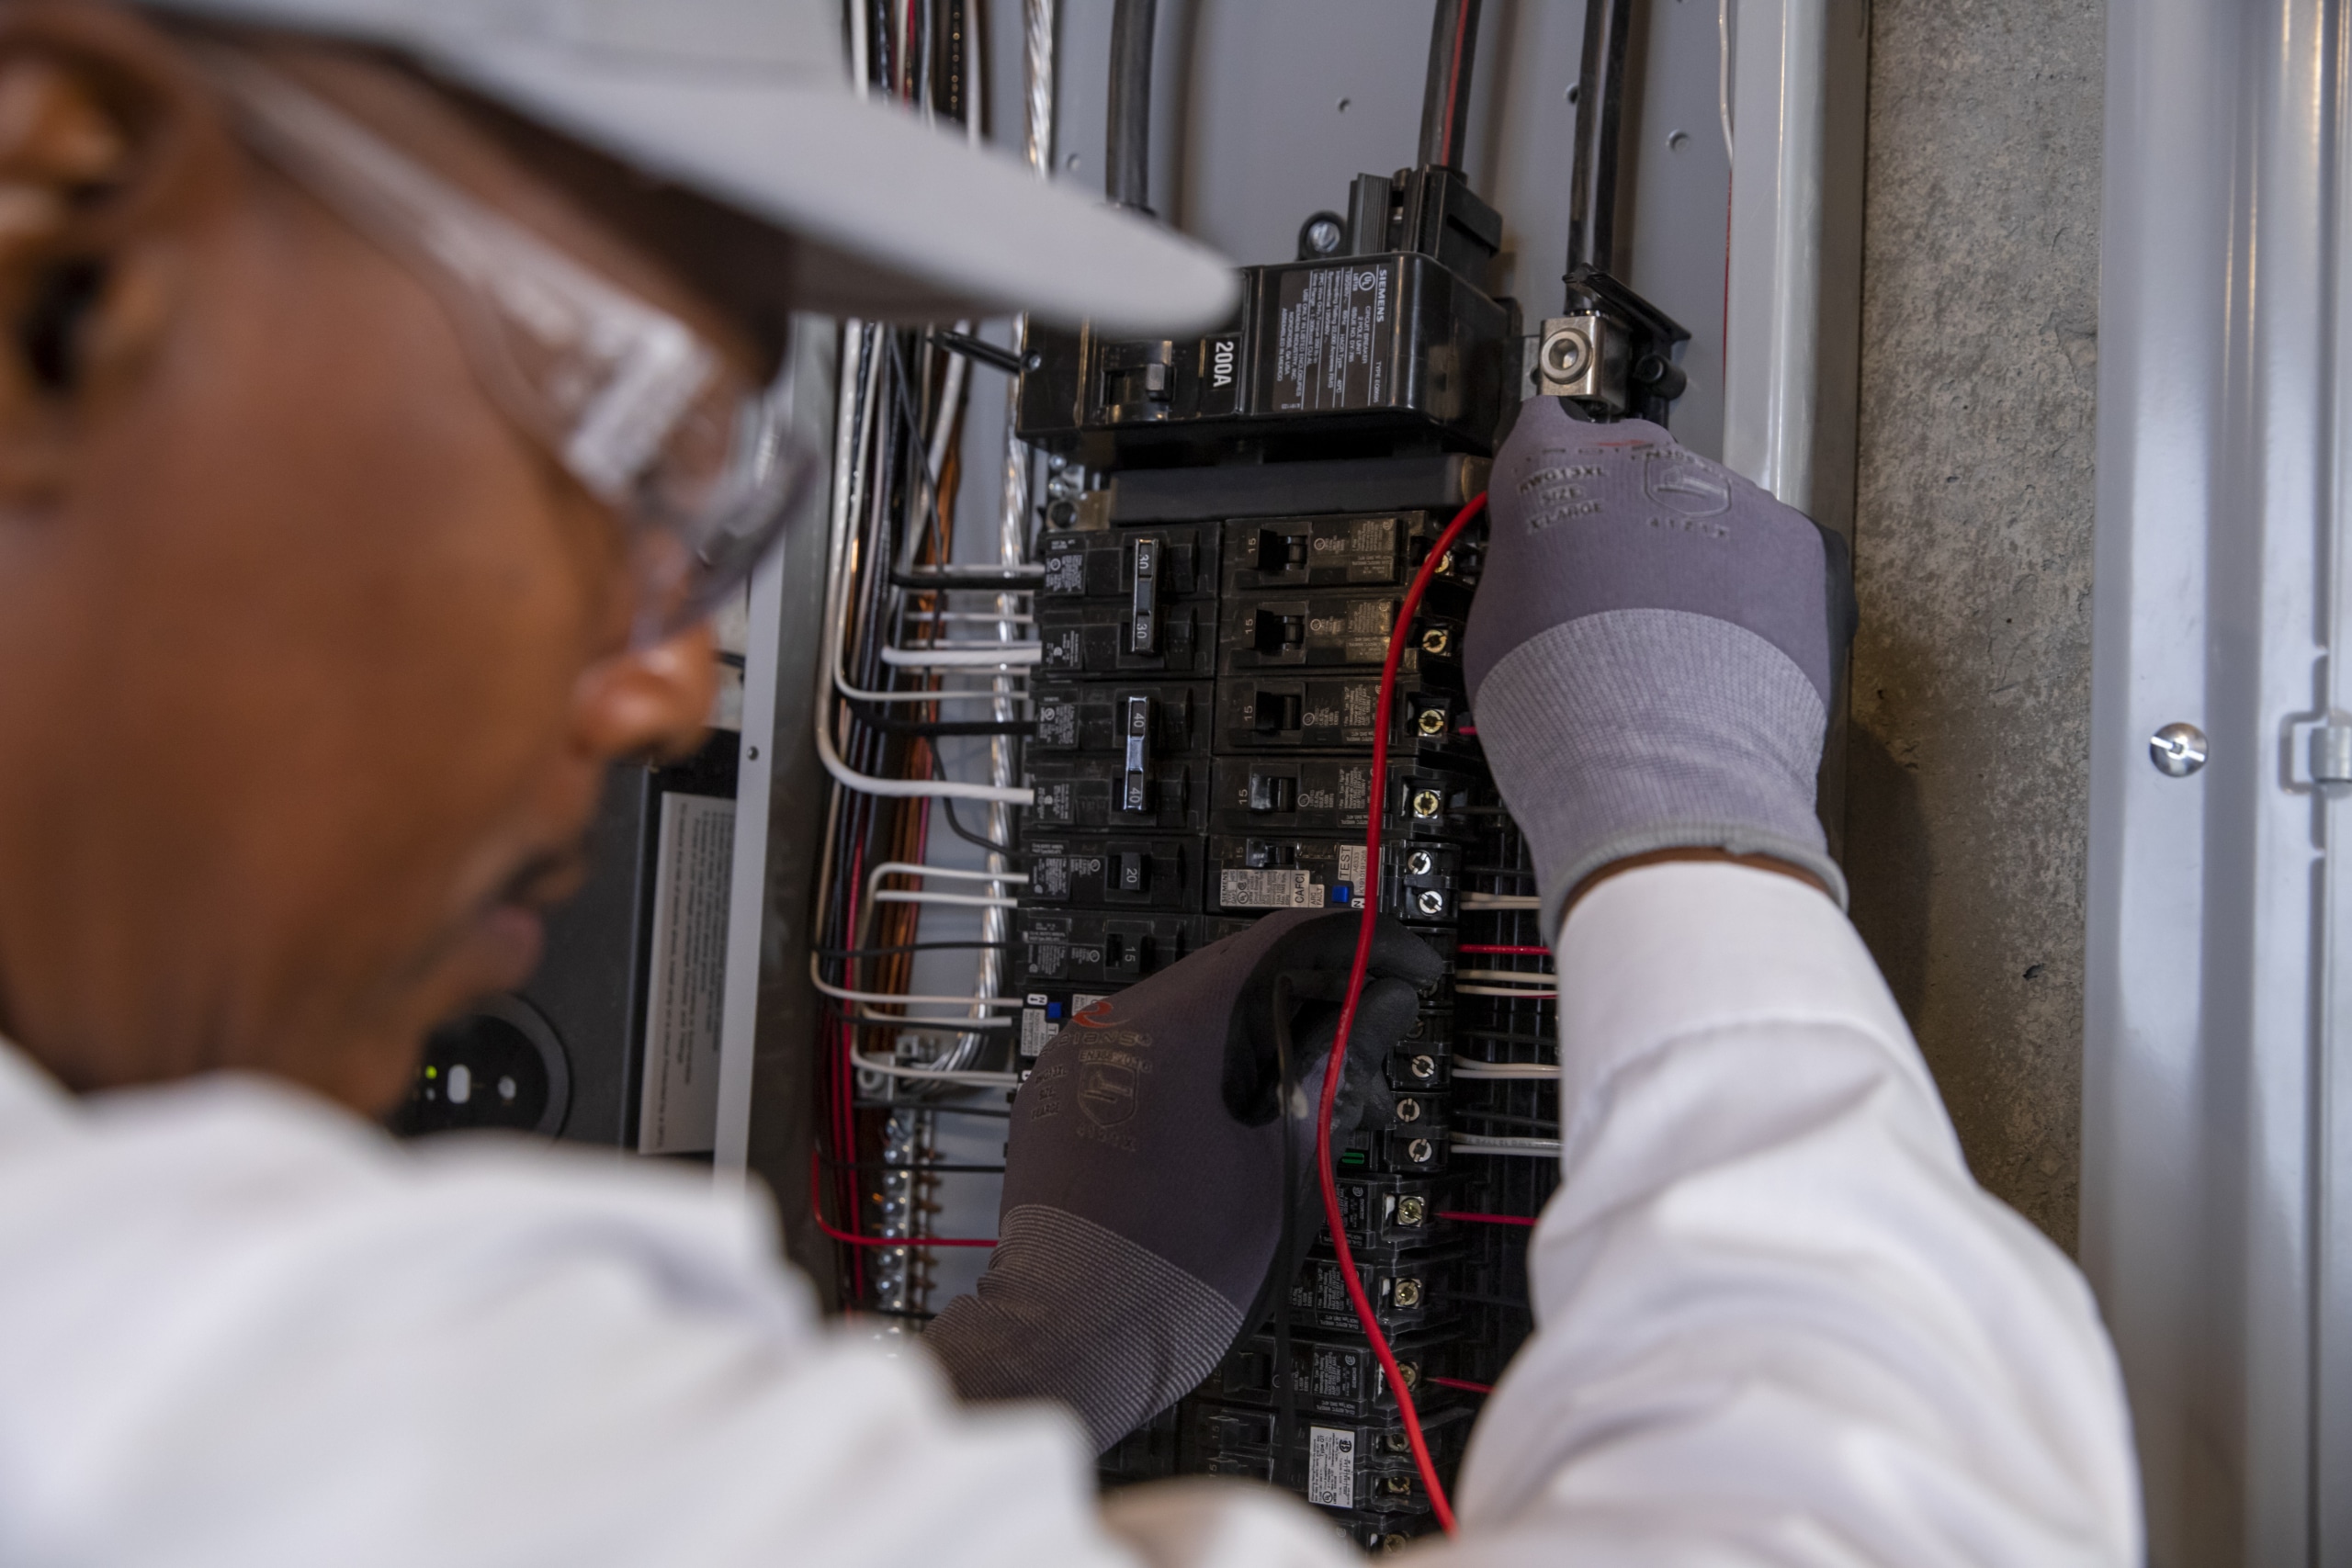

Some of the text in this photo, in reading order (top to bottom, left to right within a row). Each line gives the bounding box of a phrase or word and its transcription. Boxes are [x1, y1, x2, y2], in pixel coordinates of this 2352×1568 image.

[1376, 269, 1387, 322] SIEMENS
[1213, 341, 1234, 387] 200A
[1248, 538, 1256, 554] 15
[1137, 623, 1147, 639] 30
[1245, 619, 1253, 635] 15
[1134, 712, 1145, 727] 40
[1244, 705, 1253, 721] 15
[1129, 787, 1141, 803] 40
[1239, 789, 1248, 805] 15
[1236, 846, 1243, 858] 15
[1340, 847, 1350, 878] TEST
[1126, 868, 1138, 883] 20
[1295, 874, 1305, 903] CAFCI
[1125, 947, 1136, 962] 15
